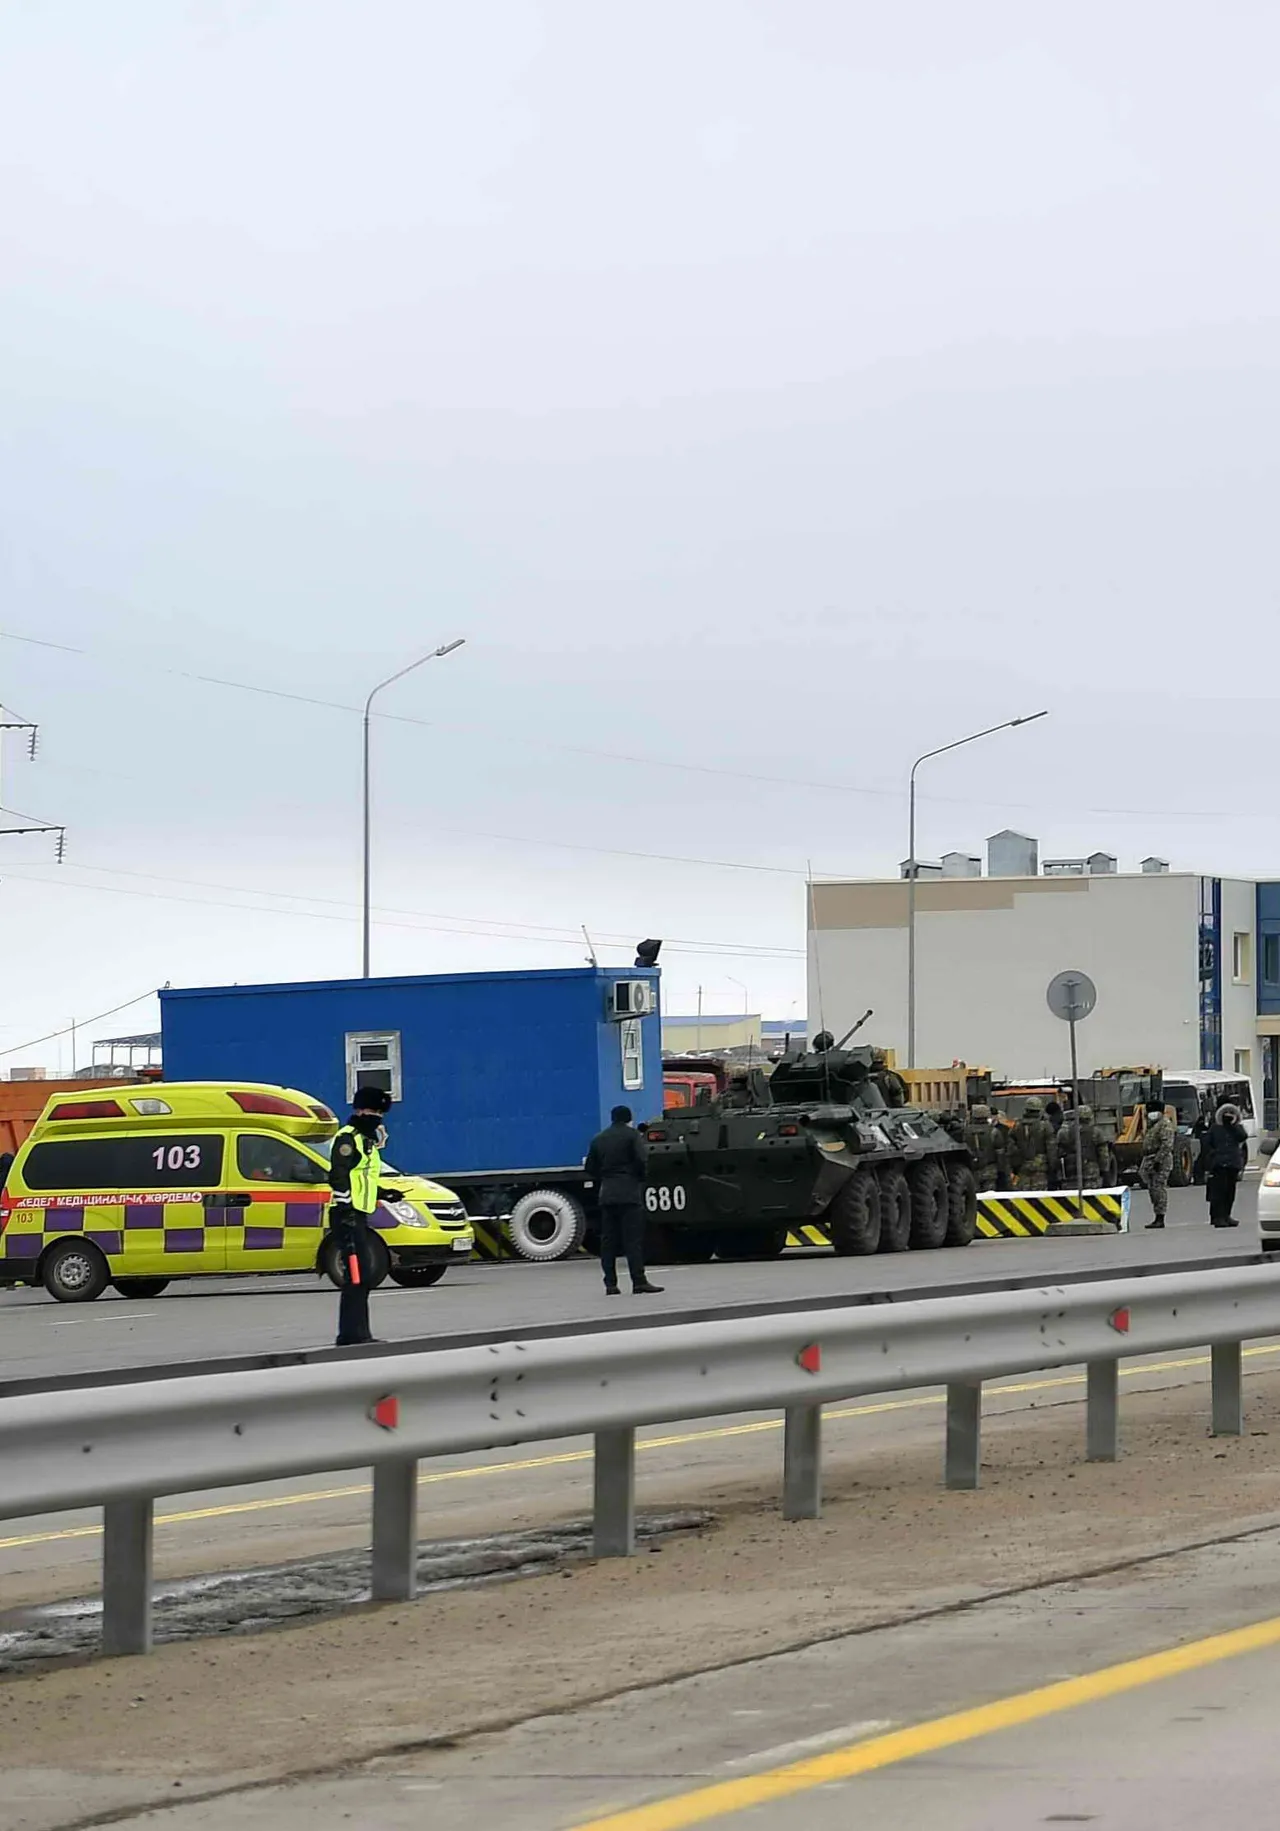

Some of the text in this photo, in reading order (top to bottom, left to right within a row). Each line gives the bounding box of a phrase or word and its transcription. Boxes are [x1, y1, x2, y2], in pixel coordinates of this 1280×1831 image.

[152, 1145, 201, 1170] 103
[144, 1192, 191, 1203] ЖӘРДЕМ
[645, 1186, 686, 1211] 680
[16, 1213, 33, 1223] 103
